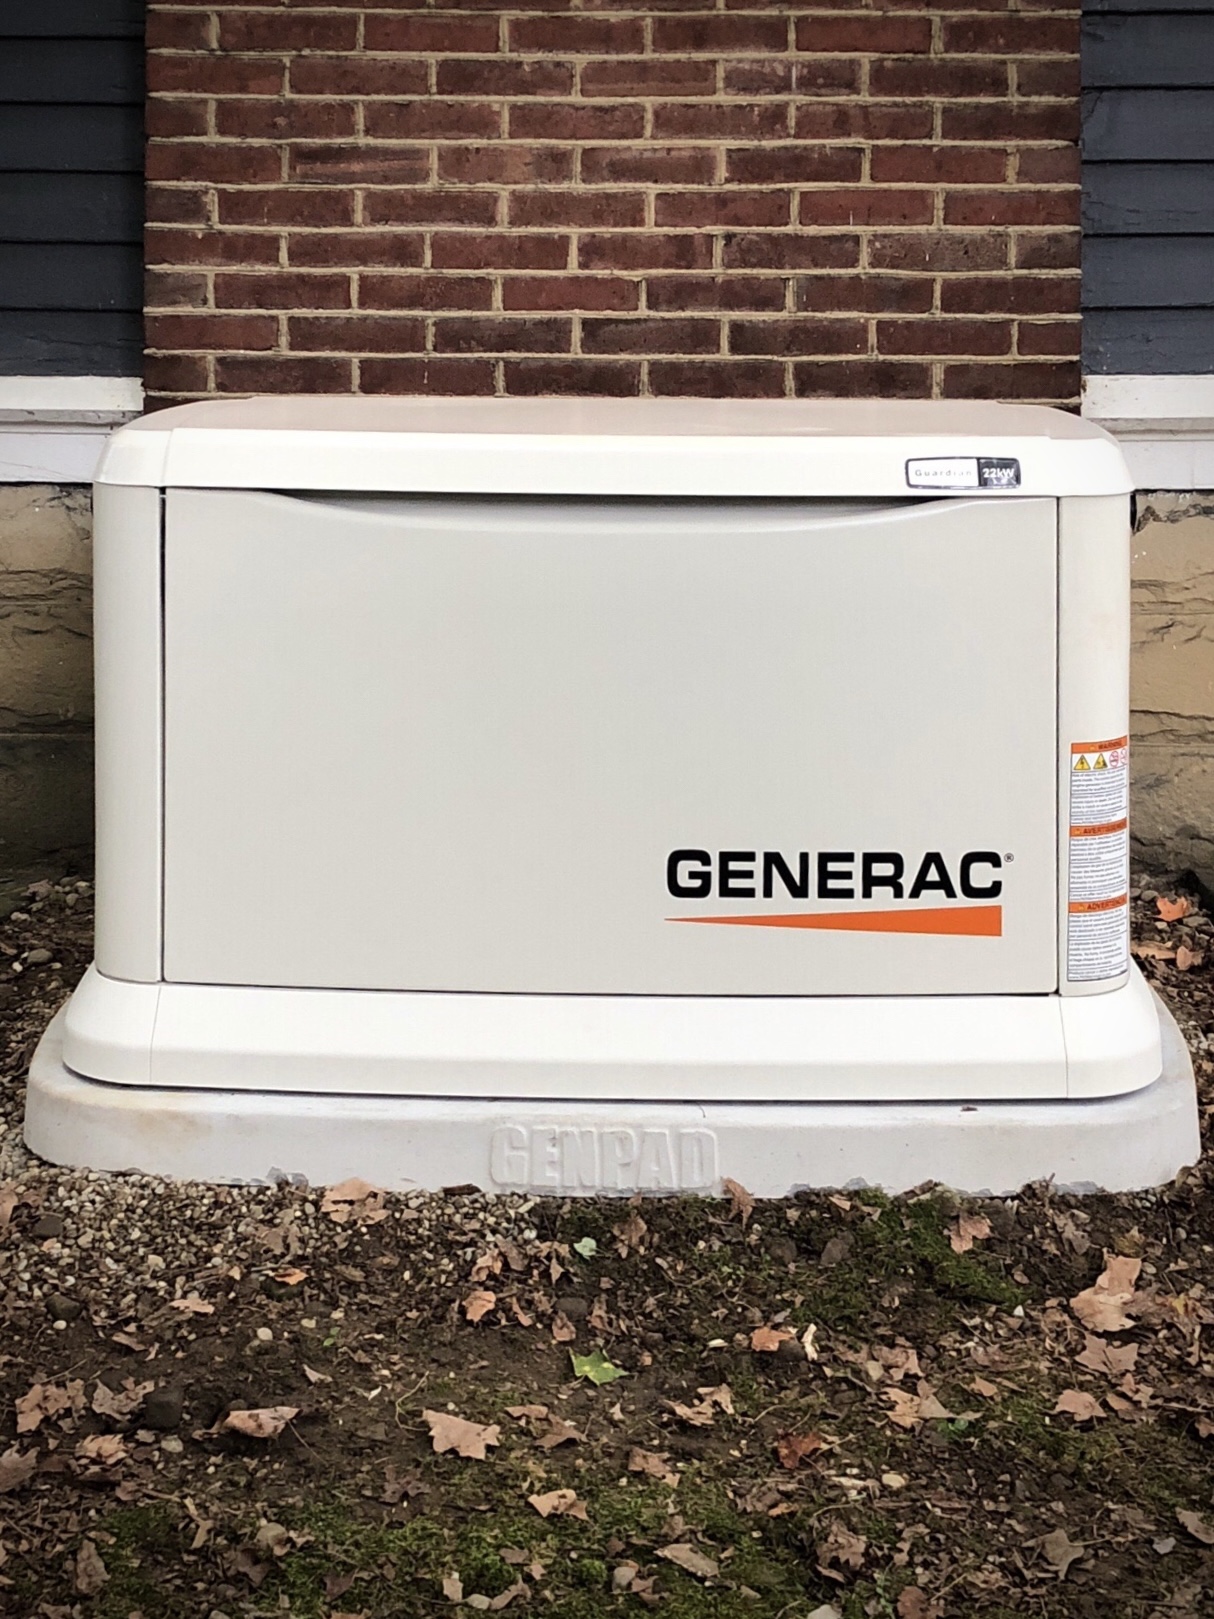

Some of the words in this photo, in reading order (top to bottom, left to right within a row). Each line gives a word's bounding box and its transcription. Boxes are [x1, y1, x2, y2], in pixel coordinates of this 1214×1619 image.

[914, 469, 972, 477] Guardian
[982, 467, 1015, 478] 22kW
[490, 1125, 719, 1190] GENPAD
